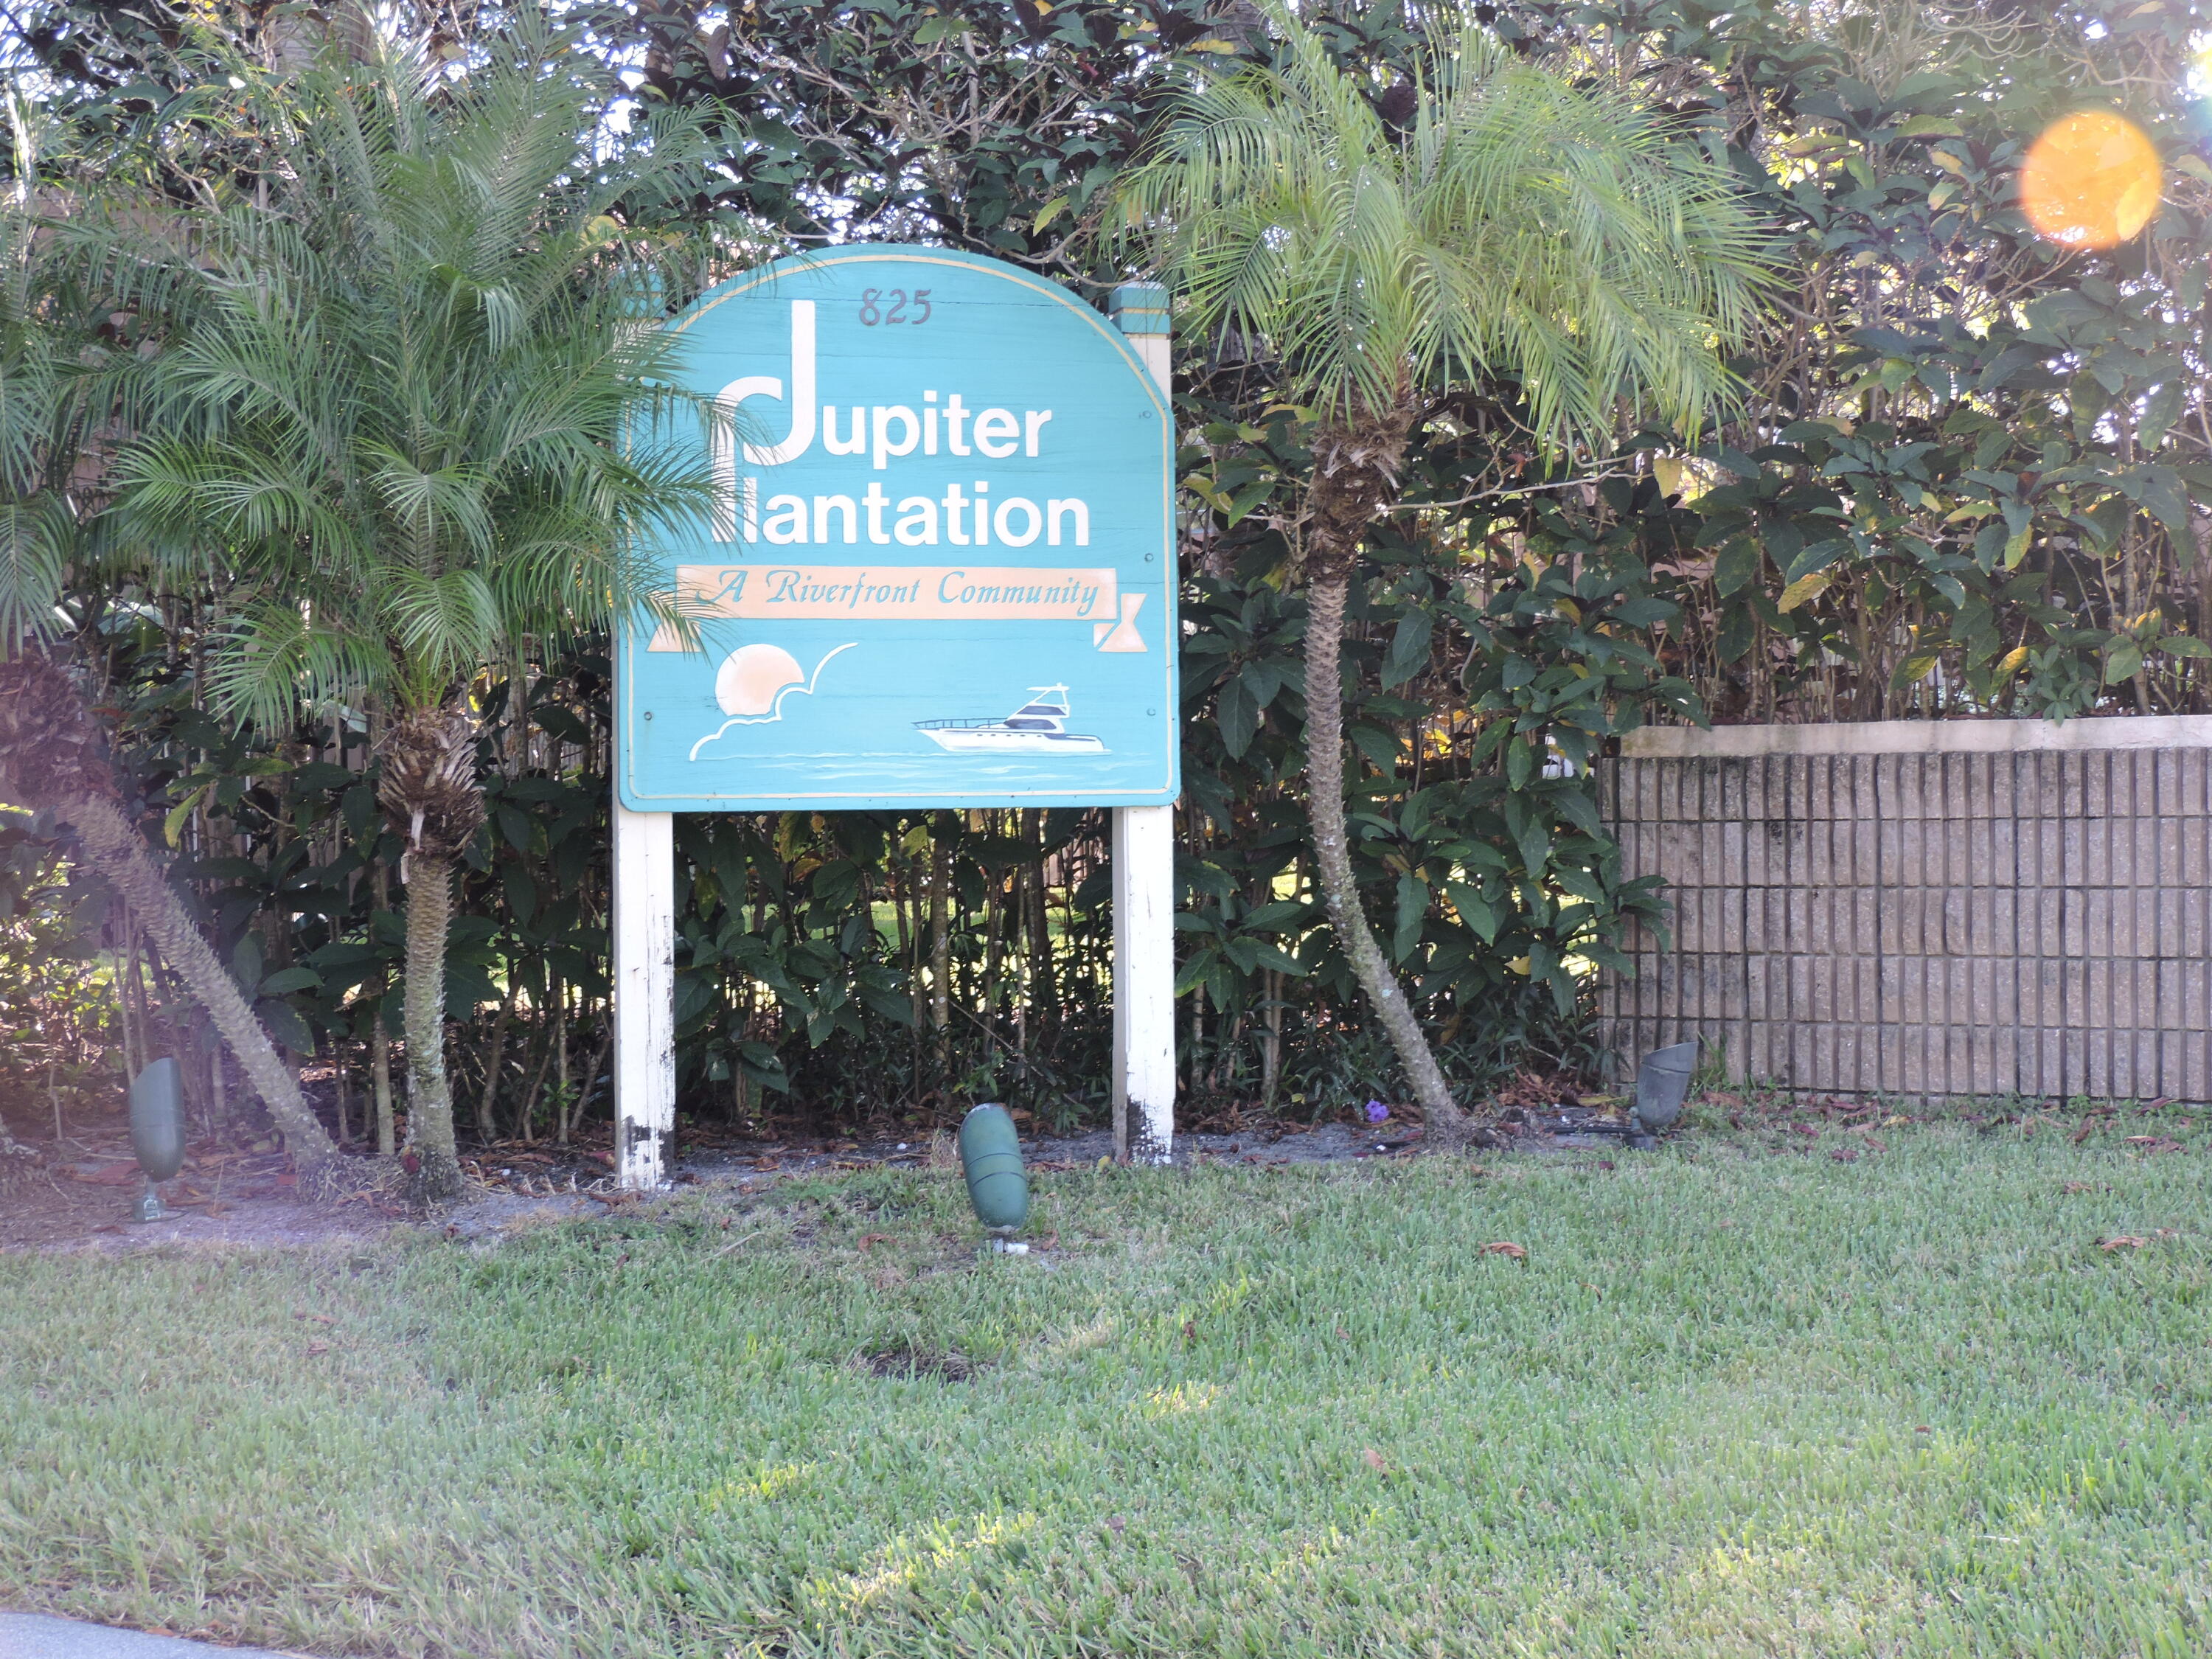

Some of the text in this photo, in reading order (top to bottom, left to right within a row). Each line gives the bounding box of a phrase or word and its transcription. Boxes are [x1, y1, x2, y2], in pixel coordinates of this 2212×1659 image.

[858, 288, 932, 327] 825
[742, 299, 1052, 470] Jupiter
[710, 375, 1090, 546] Plantation
[695, 569, 1099, 617] A Riverfront Community
